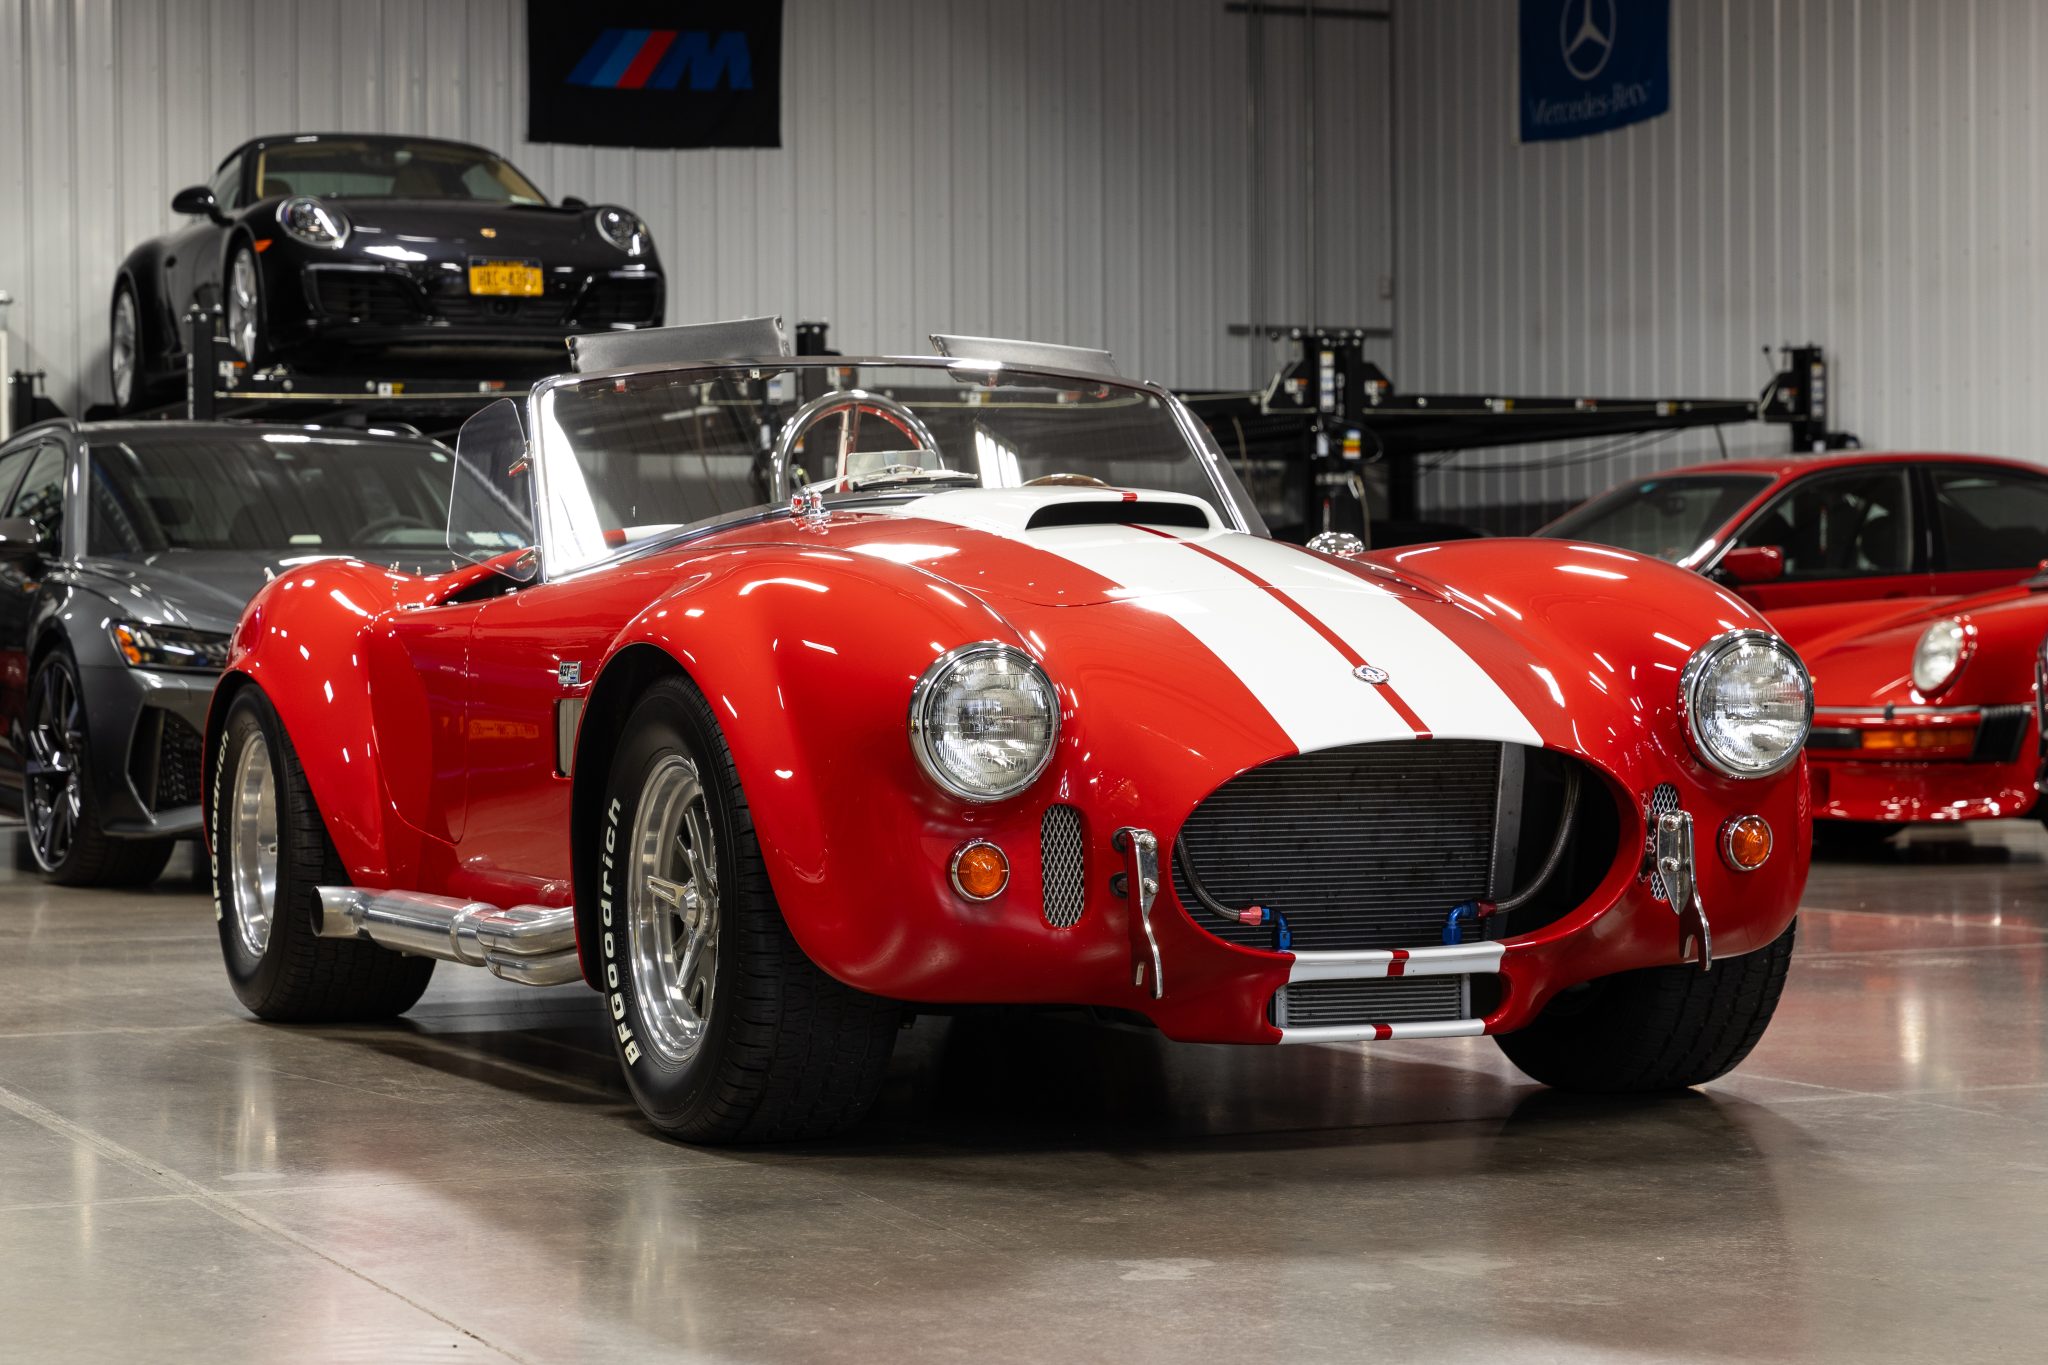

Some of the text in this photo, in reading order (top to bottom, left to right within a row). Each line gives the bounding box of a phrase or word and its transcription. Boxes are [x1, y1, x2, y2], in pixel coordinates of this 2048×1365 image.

[1529, 81, 1654, 127] Mercedes-Benz
[559, 664, 570, 677] 427
[211, 730, 230, 921] BFGoodrich
[600, 797, 642, 1066] BFGoodrich
